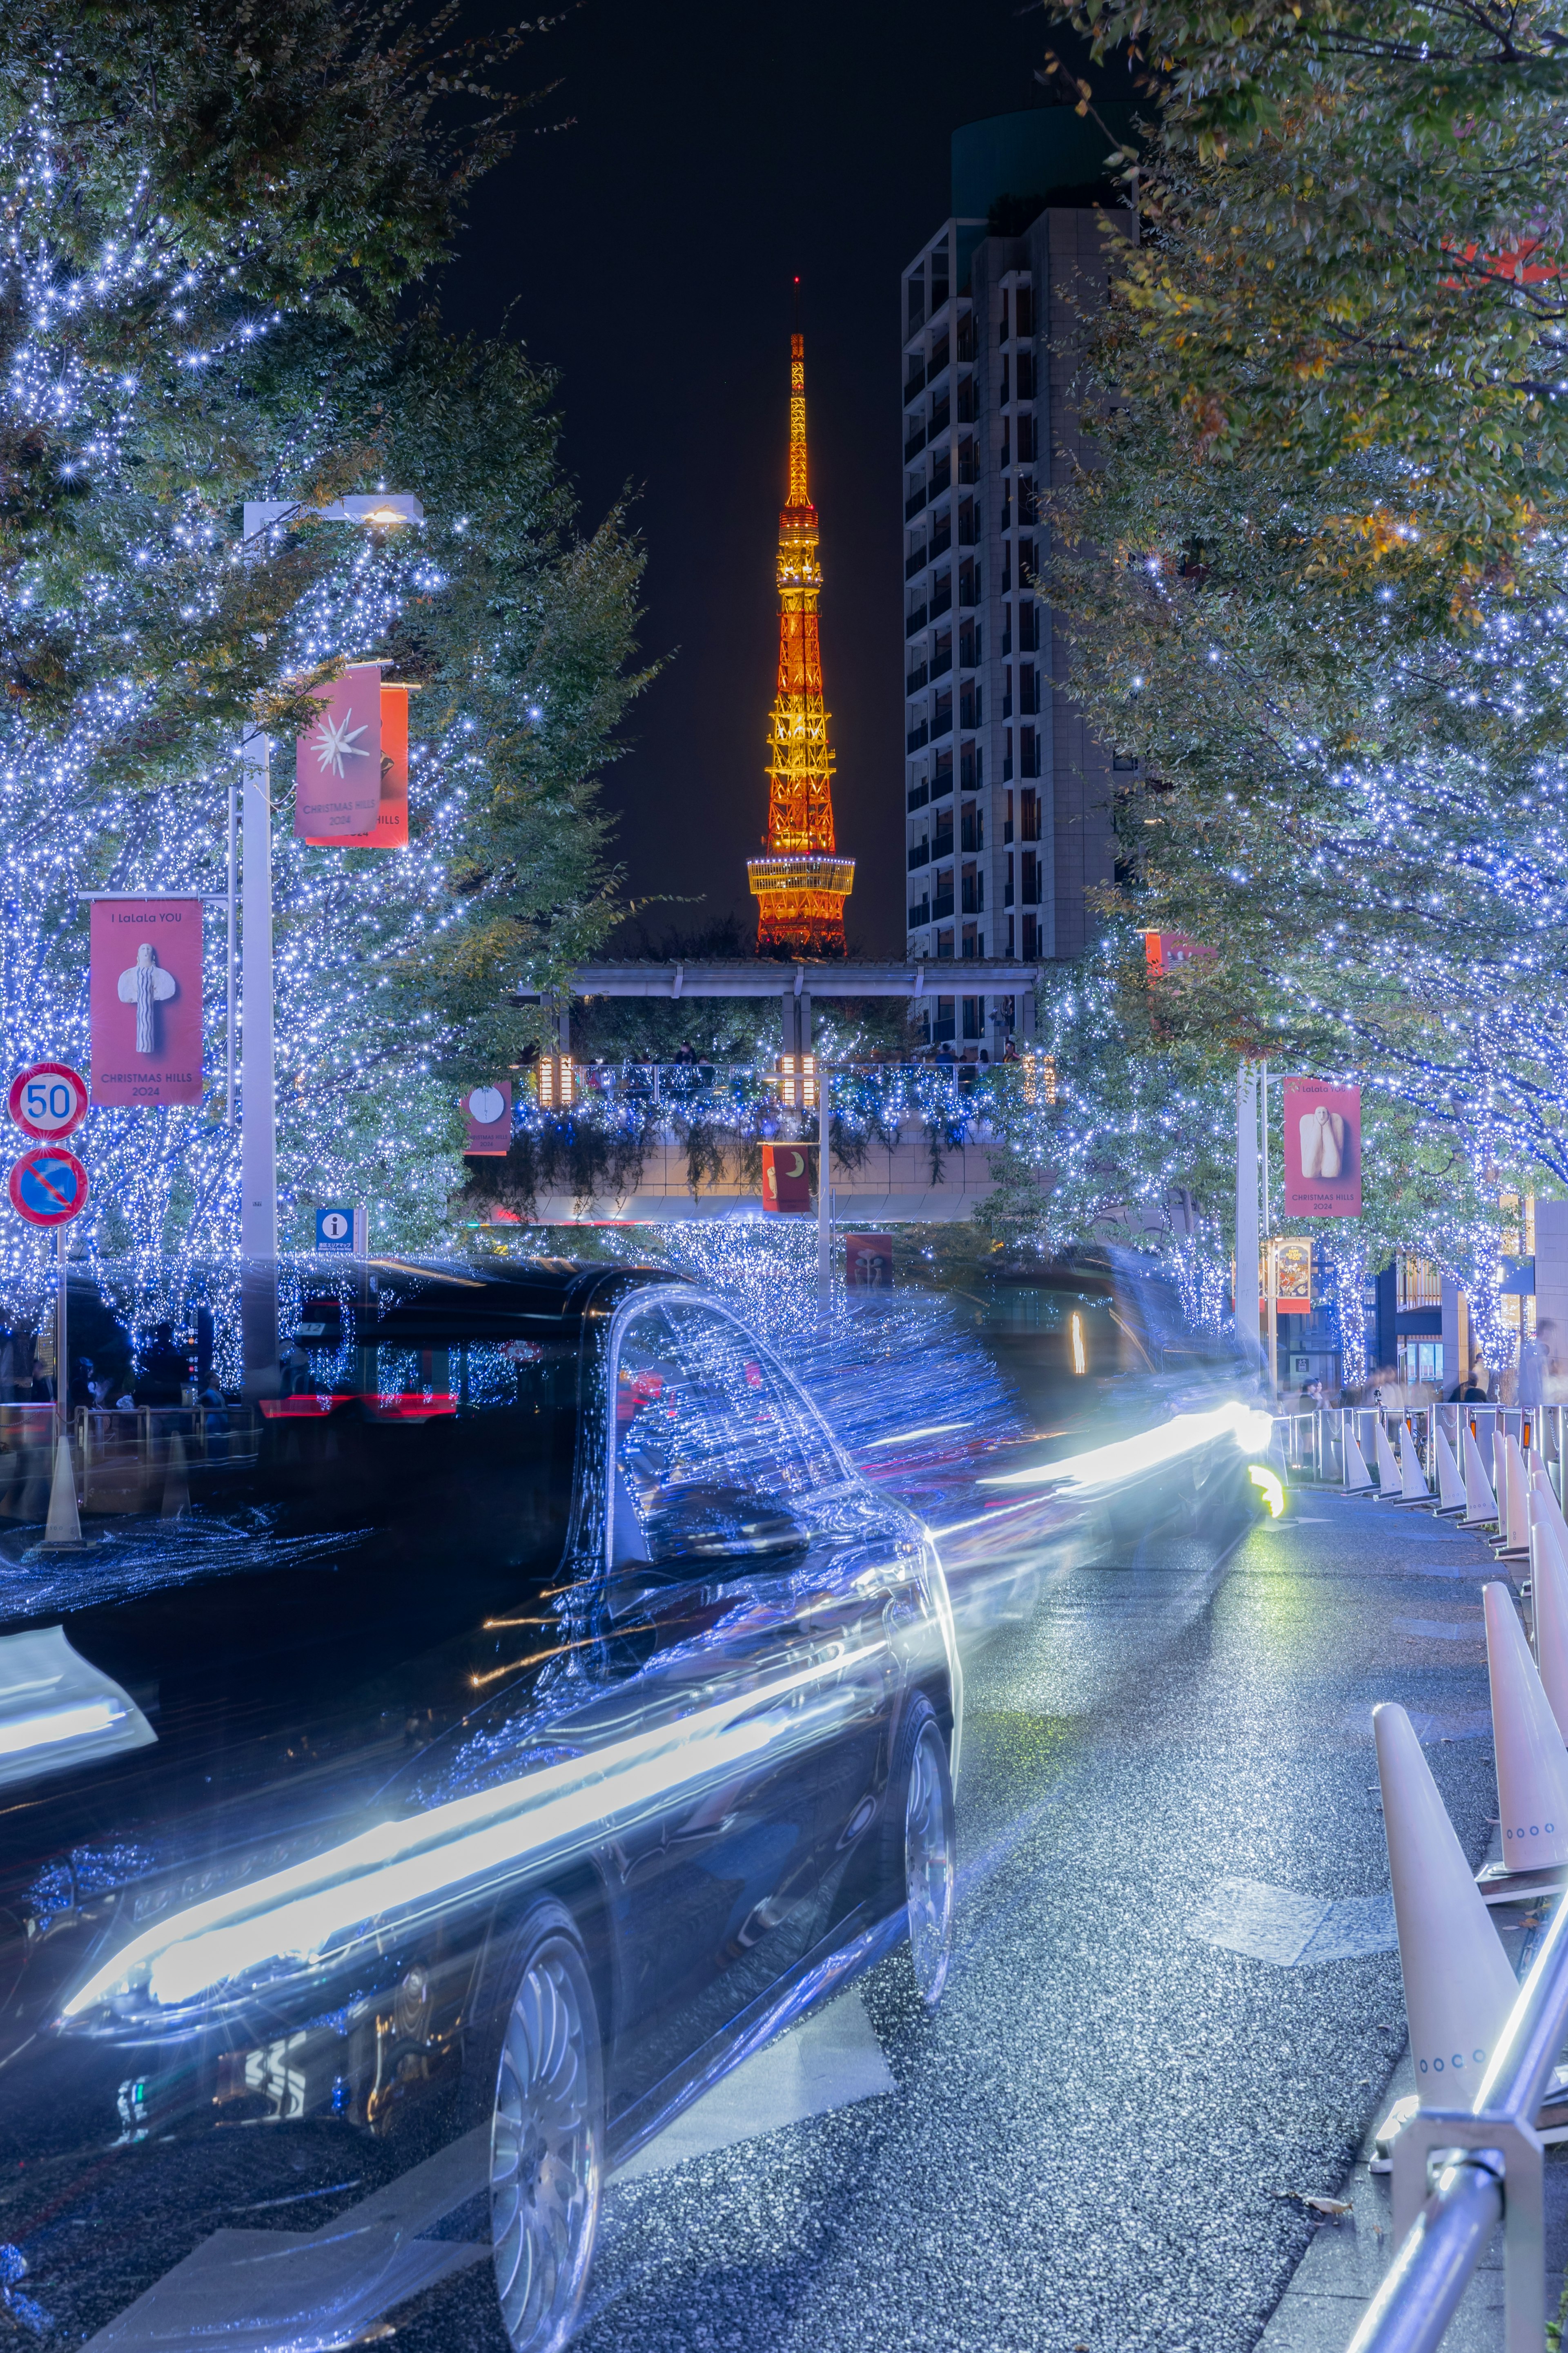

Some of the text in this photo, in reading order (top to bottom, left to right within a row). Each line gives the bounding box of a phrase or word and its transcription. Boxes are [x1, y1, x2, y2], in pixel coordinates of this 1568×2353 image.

[303, 799, 375, 814] CHRISTMAS HILLS
[329, 816, 351, 825] 2024
[111, 913, 181, 922] I LaLaLa YOU
[101, 1073, 192, 1083] CHRISTMAS HILLS
[132, 1087, 160, 1096] 2024
[28, 1085, 69, 1118] 50
